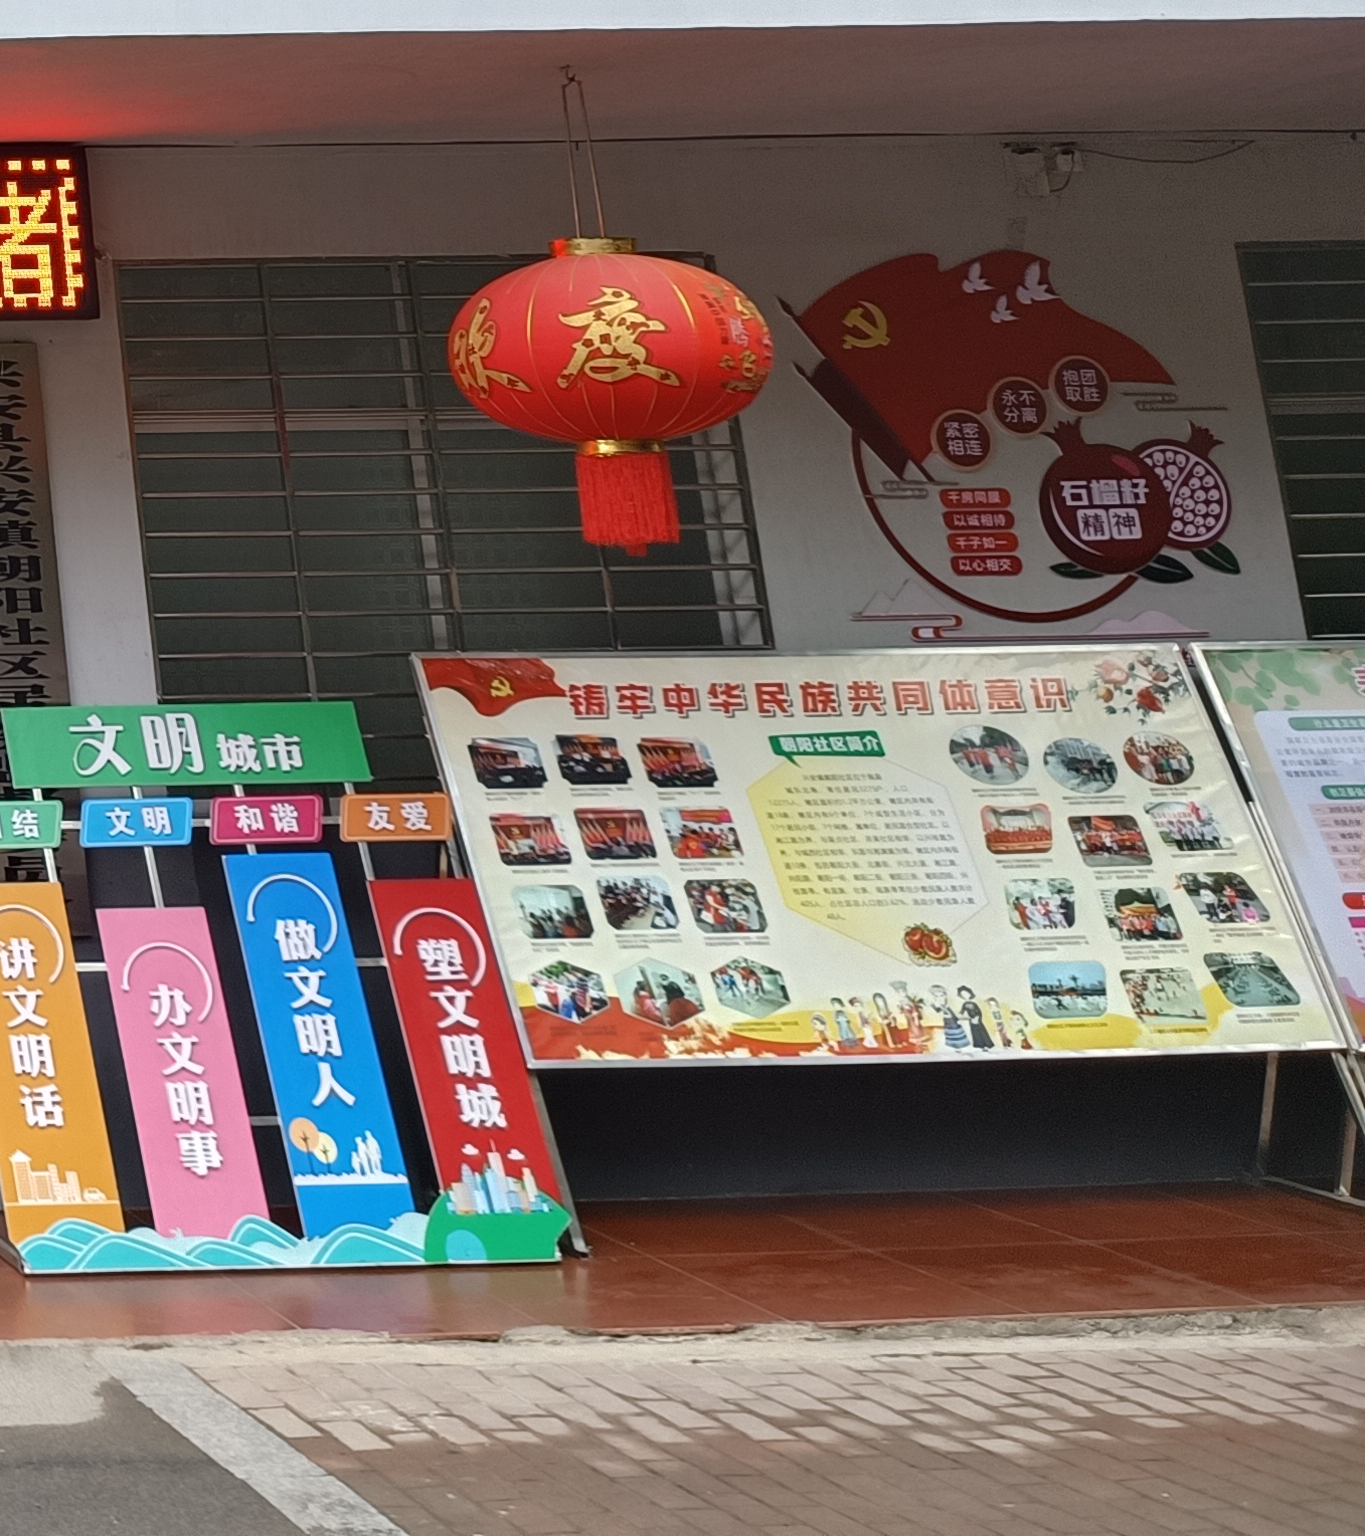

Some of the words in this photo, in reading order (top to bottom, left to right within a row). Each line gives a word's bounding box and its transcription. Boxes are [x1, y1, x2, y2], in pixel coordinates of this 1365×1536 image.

[1062, 369, 1097, 386] 抱团
[1002, 389, 1036, 406] 永不
[1065, 386, 1101, 402] 取胜
[1003, 407, 1038, 423] 分离
[944, 422, 980, 439] 紧密
[948, 439, 983, 455] 相连
[1060, 478, 1149, 506] 石榴籽
[1081, 512, 1136, 537] 精神
[958, 558, 1012, 572] 以心相交
[568, 677, 1072, 719] 铸牢中华民族共同体意识
[778, 736, 880, 752] 朝阳社区简介
[105, 804, 173, 836] 文明
[235, 801, 301, 834] 和谐
[366, 801, 433, 832] 友爱
[274, 918, 356, 1108] 做文明人
[417, 937, 508, 1131] 塑文明城
[148, 983, 223, 1178] 办文明事
